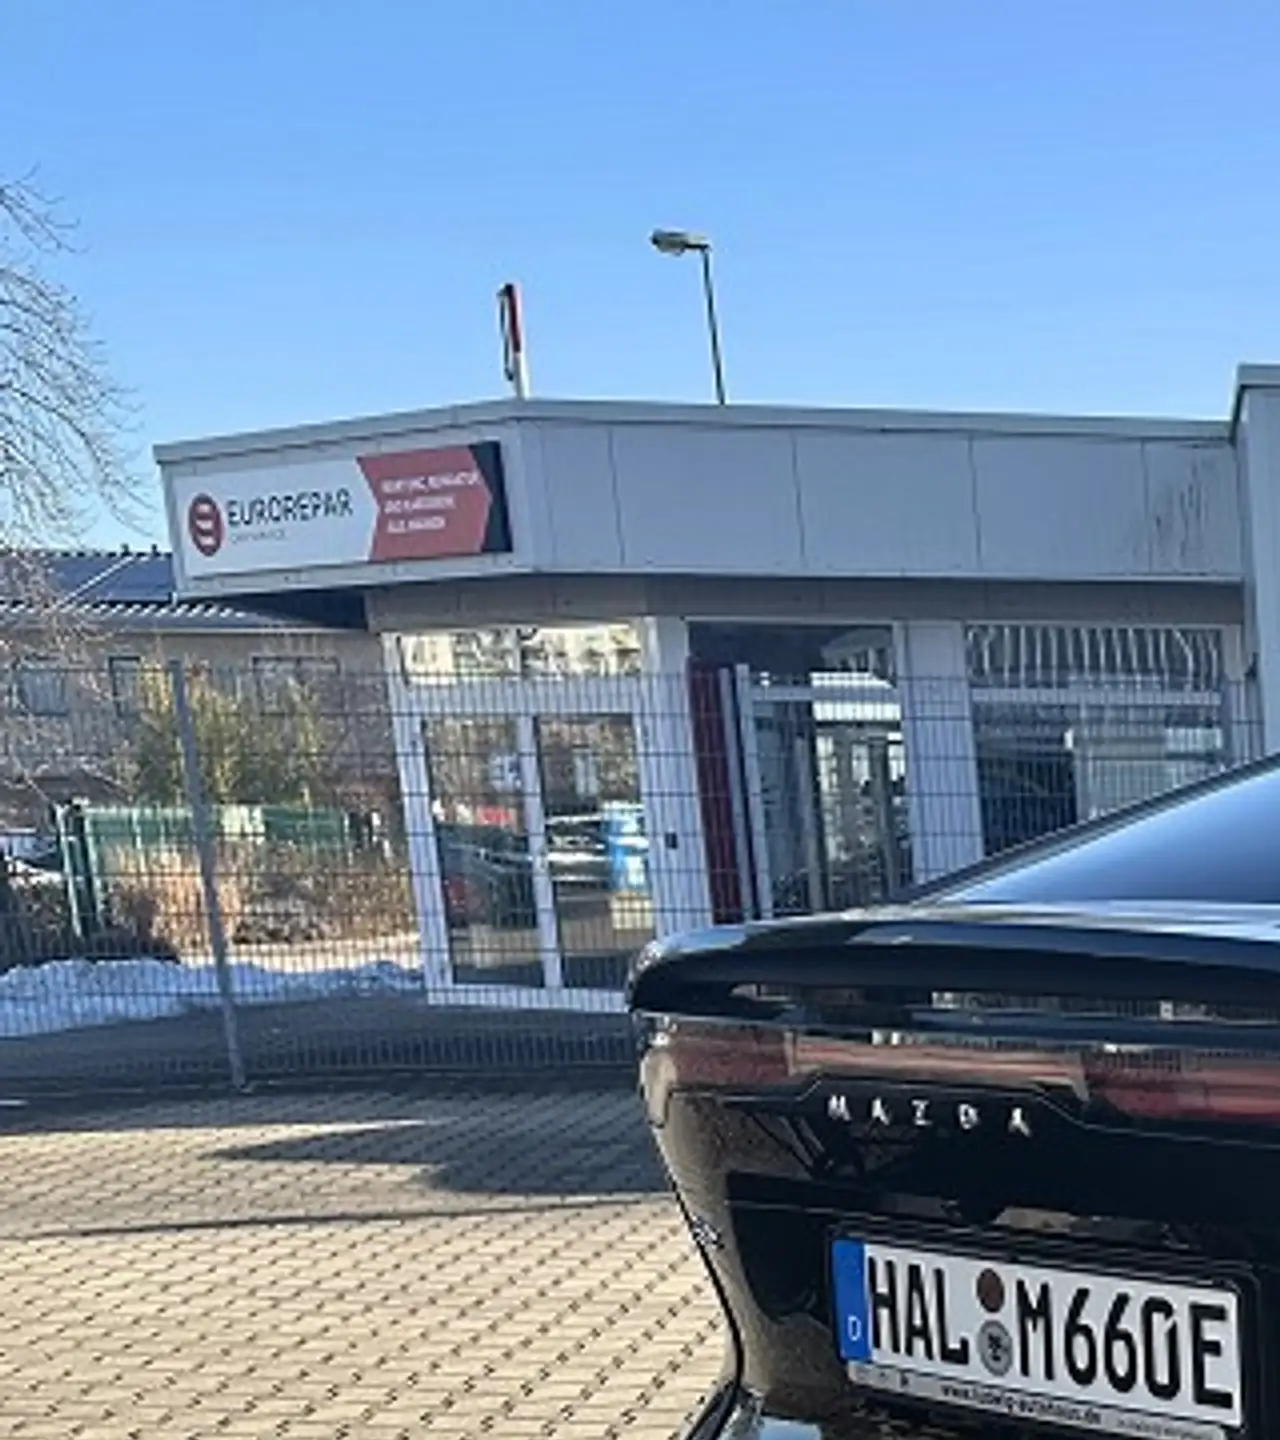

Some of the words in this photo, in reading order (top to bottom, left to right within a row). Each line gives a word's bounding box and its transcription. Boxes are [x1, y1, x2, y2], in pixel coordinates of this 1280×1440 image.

[228, 488, 353, 525] EUROREPAR
[828, 1094, 1031, 1137] MAZDA
[868, 1256, 970, 1365] HAL
[1016, 1279, 1232, 1409] M660E
